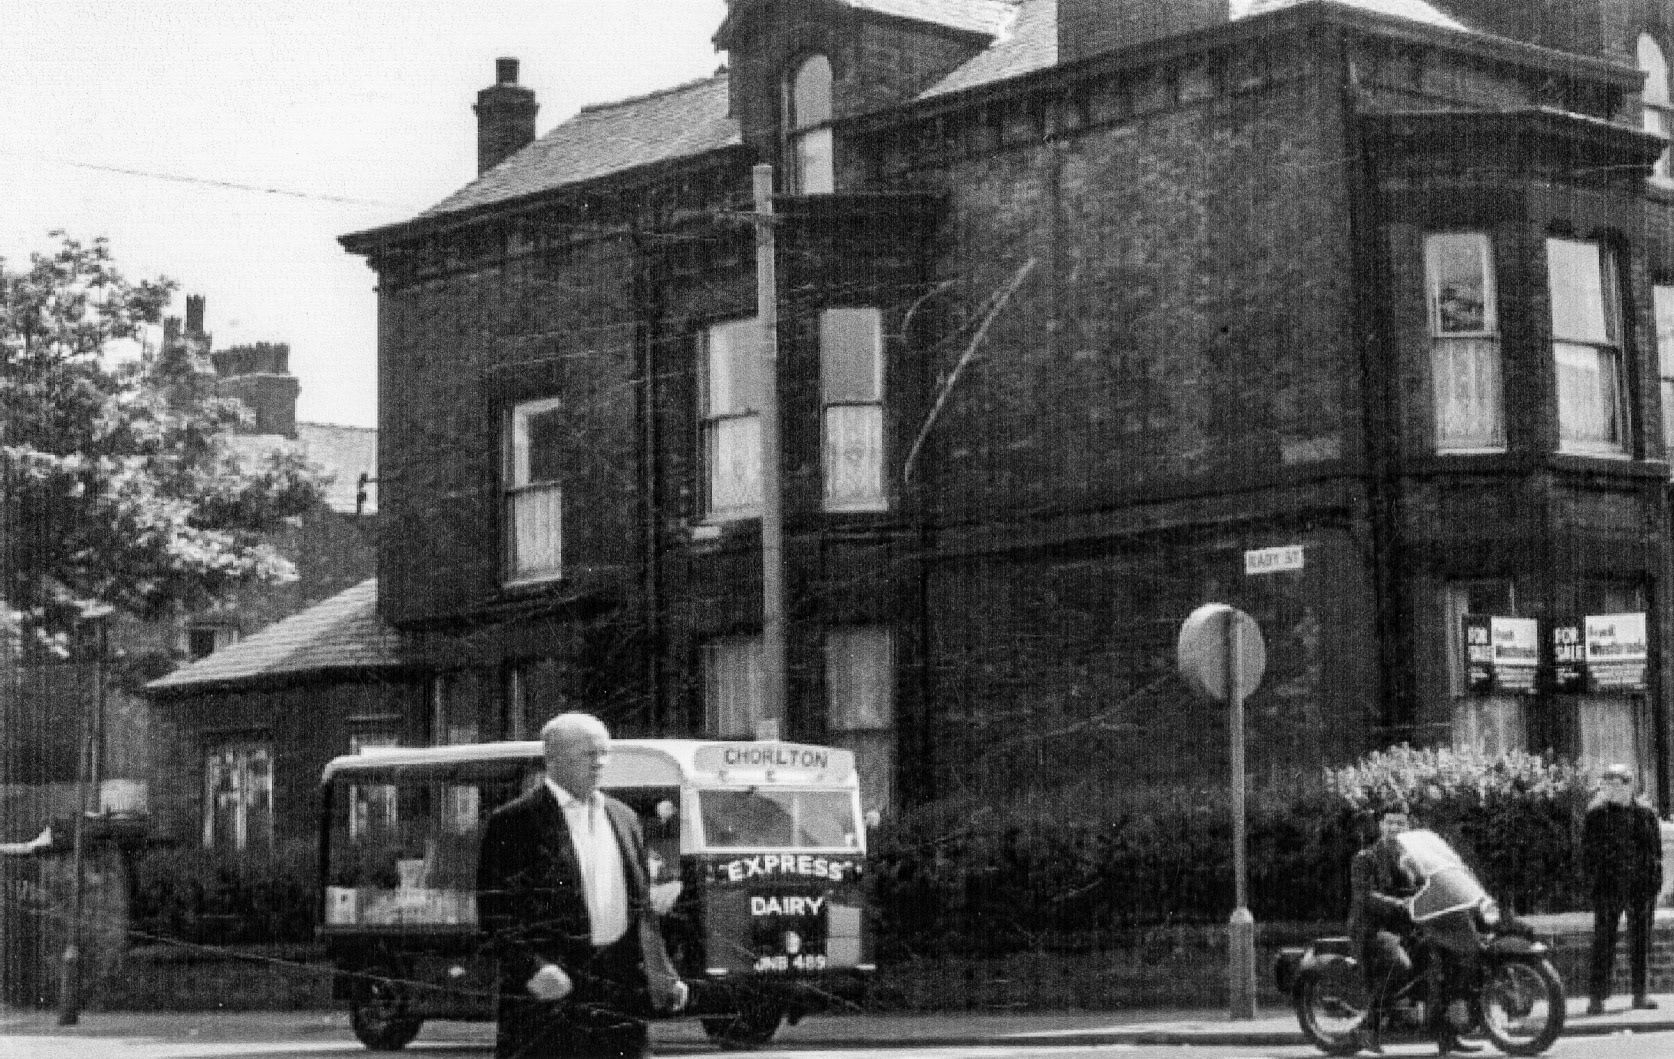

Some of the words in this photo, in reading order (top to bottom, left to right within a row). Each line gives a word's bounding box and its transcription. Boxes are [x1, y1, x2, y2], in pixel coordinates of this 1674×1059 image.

[1554, 626, 1579, 645] FOR
[723, 748, 829, 768] CHORLTON
[751, 896, 825, 916] DAIRY
